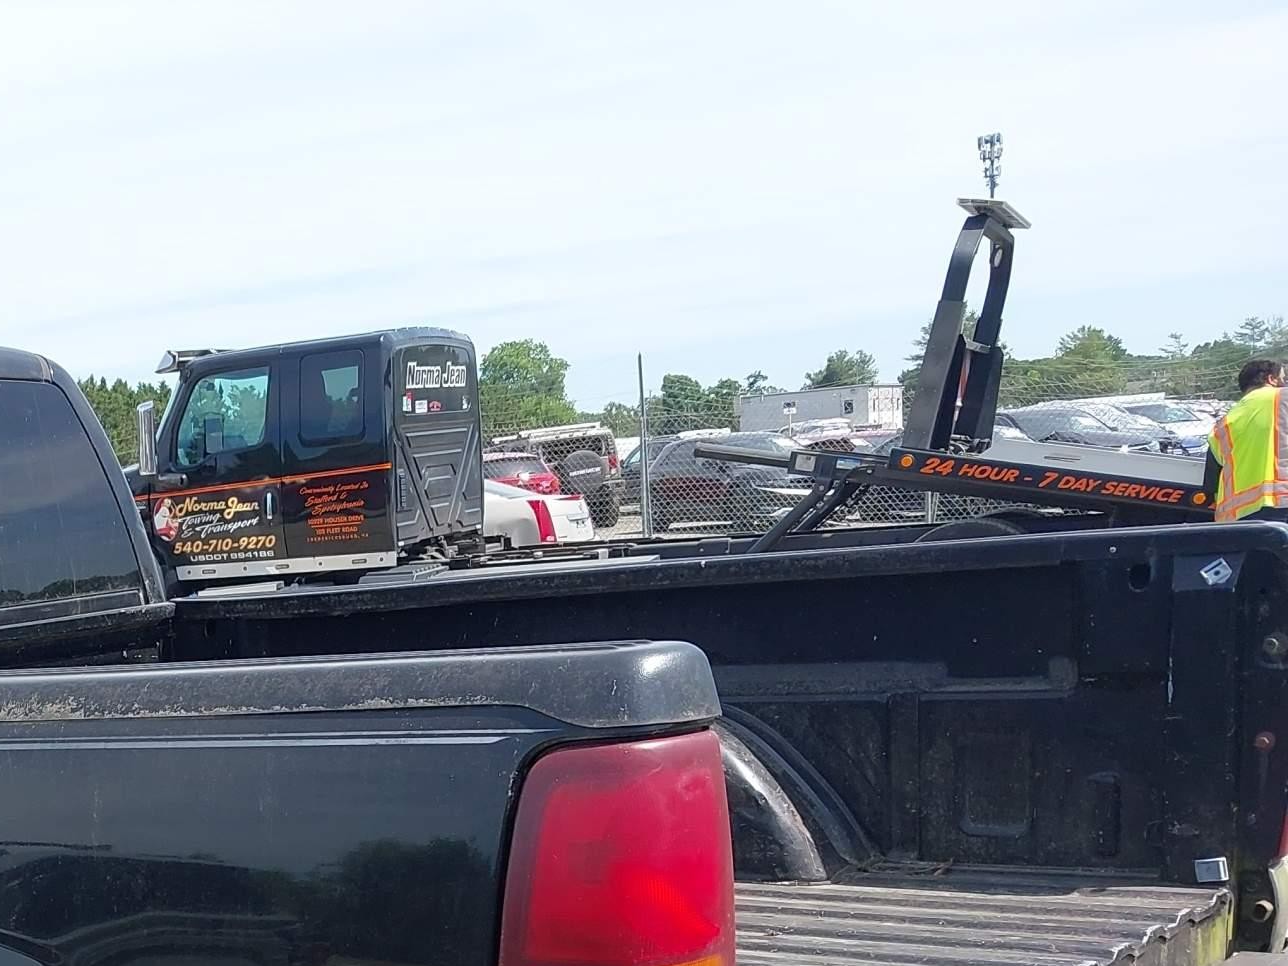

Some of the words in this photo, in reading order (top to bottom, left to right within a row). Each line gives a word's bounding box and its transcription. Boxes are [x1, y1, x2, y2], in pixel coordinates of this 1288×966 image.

[406, 361, 441, 388] Norma
[442, 361, 467, 388] Jean
[920, 457, 954, 477] 24
[958, 463, 1019, 482] HOUR
[1038, 471, 1057, 488] 7
[1058, 476, 1101, 492] DAY
[1100, 482, 1186, 503] SERVICE
[176, 497, 227, 516] Norma
[224, 497, 260, 519] Jean
[179, 512, 222, 529] Towing
[196, 516, 260, 538] Transport
[173, 535, 276, 554] 540-710-9270
[190, 553, 229, 562] USDOT
